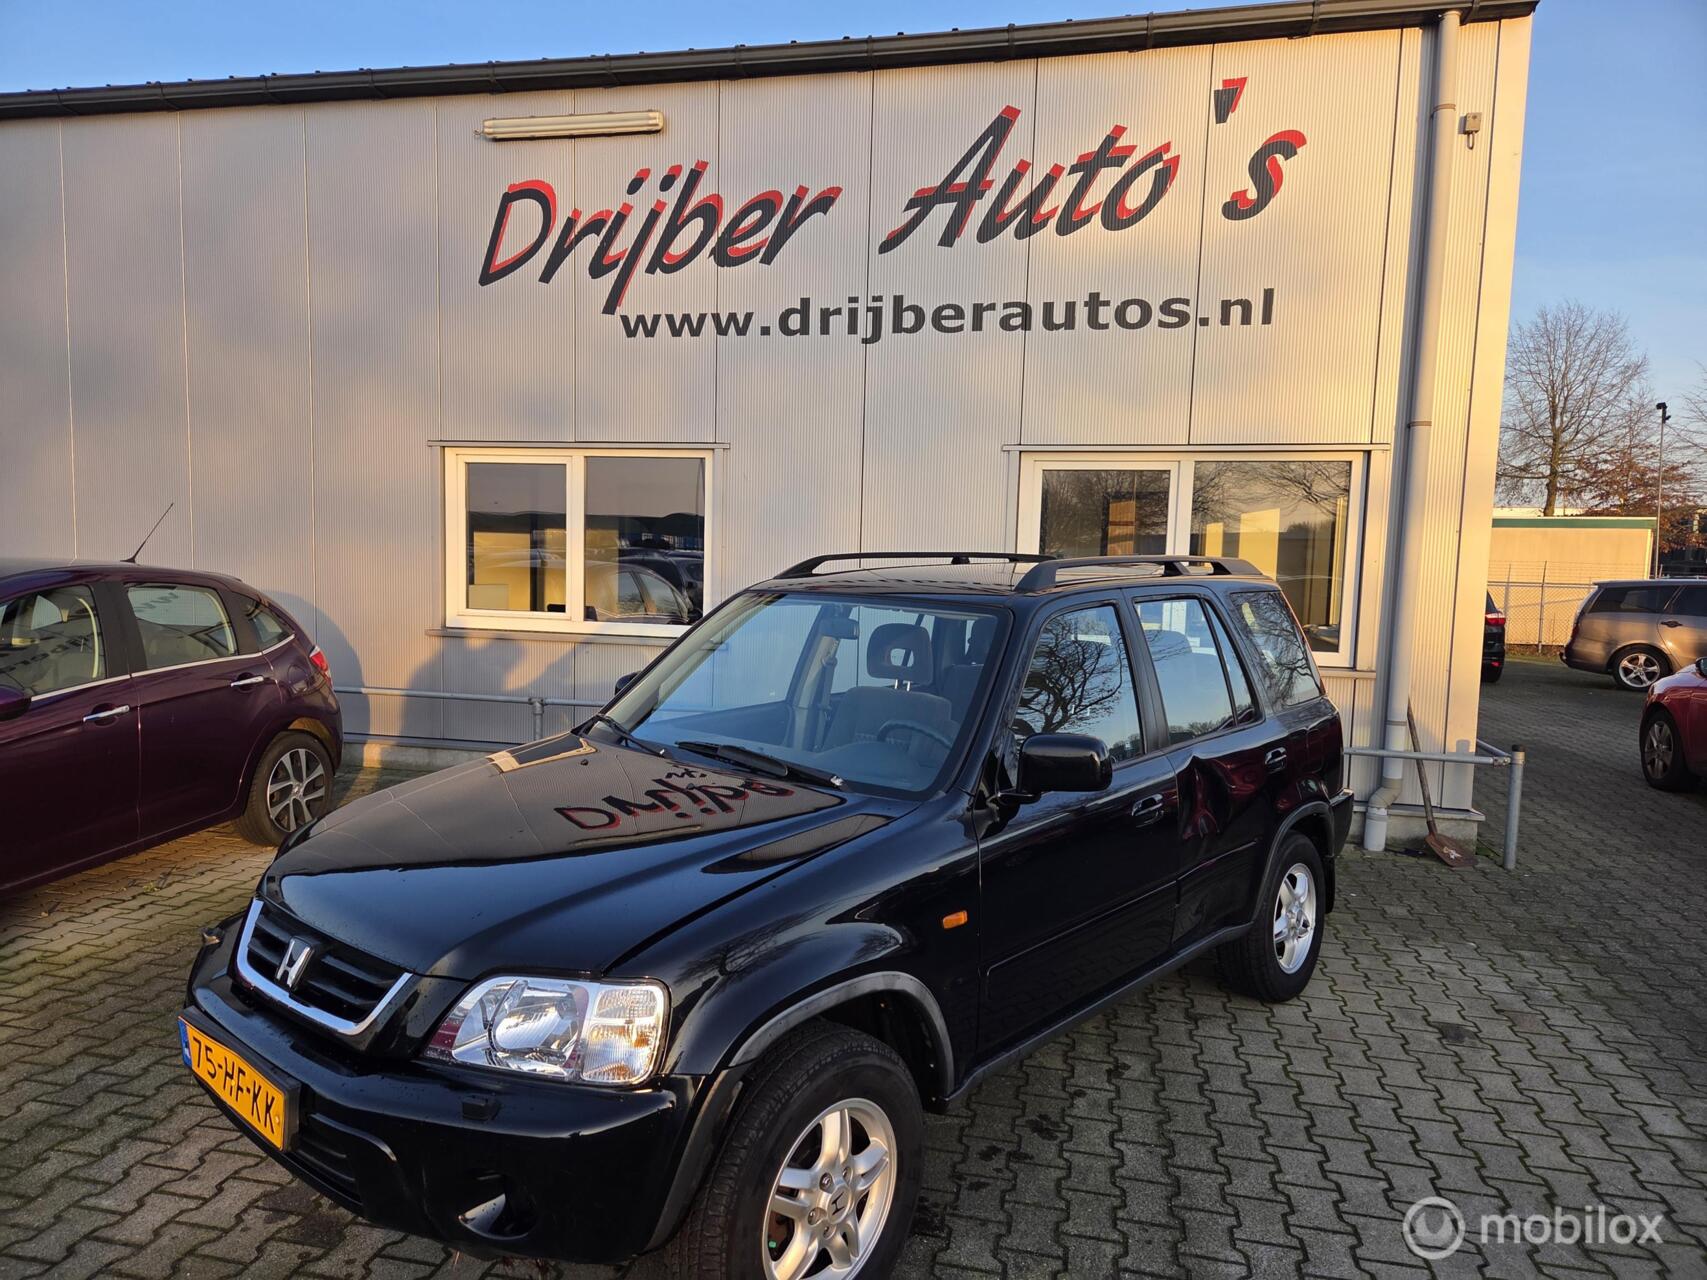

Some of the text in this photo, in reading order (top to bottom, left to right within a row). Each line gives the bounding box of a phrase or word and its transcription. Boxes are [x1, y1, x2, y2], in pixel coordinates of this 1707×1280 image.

[478, 76, 1308, 315] Drijber Auto's
[619, 287, 1275, 345] www.drijberautos.nl
[192, 1036, 277, 1135] 75-HF-KK
